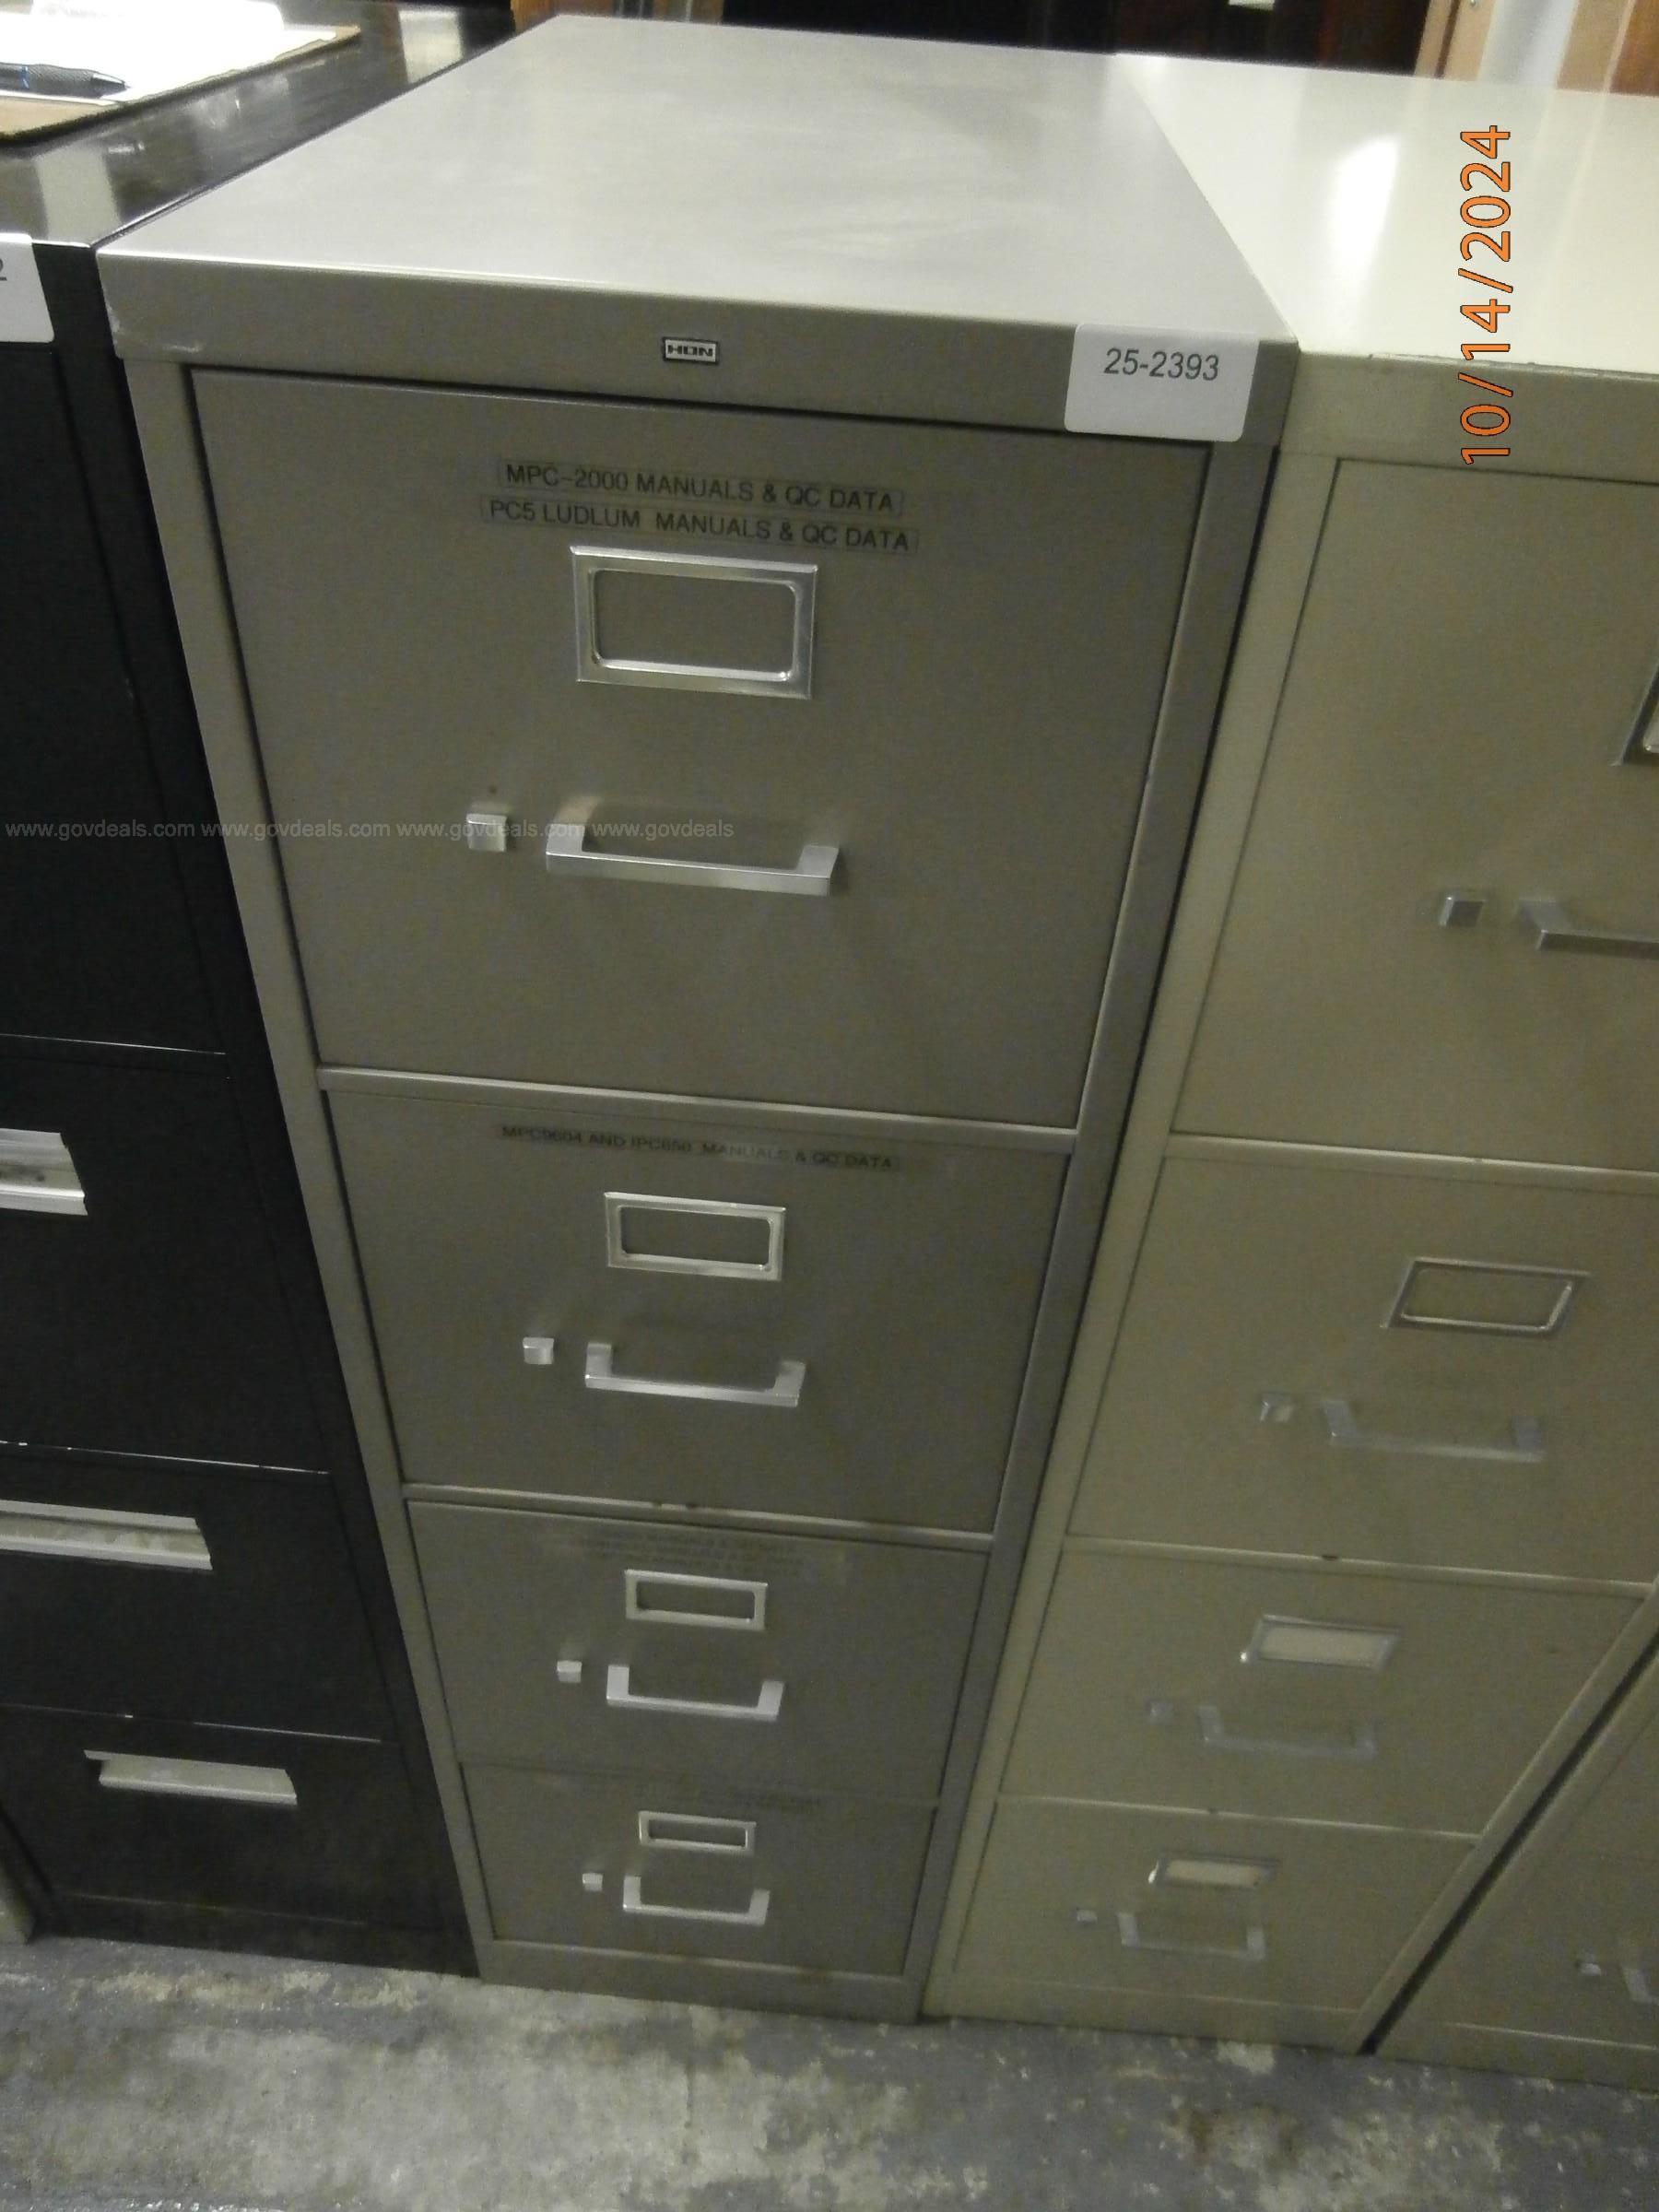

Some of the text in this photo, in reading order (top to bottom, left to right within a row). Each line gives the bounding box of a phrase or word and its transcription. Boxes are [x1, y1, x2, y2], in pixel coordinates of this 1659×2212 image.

[667, 345, 713, 357] HON
[1103, 347, 1219, 381] 25-2393
[505, 464, 893, 512] MPC-2000 MANUALS & QC DATA
[489, 500, 909, 551] PC5 LUDLUM MANUALS & QC DATA
[588, 1132, 627, 1147] AND
[701, 1141, 788, 1160] MANUALS
[845, 1154, 892, 1170] DATA
